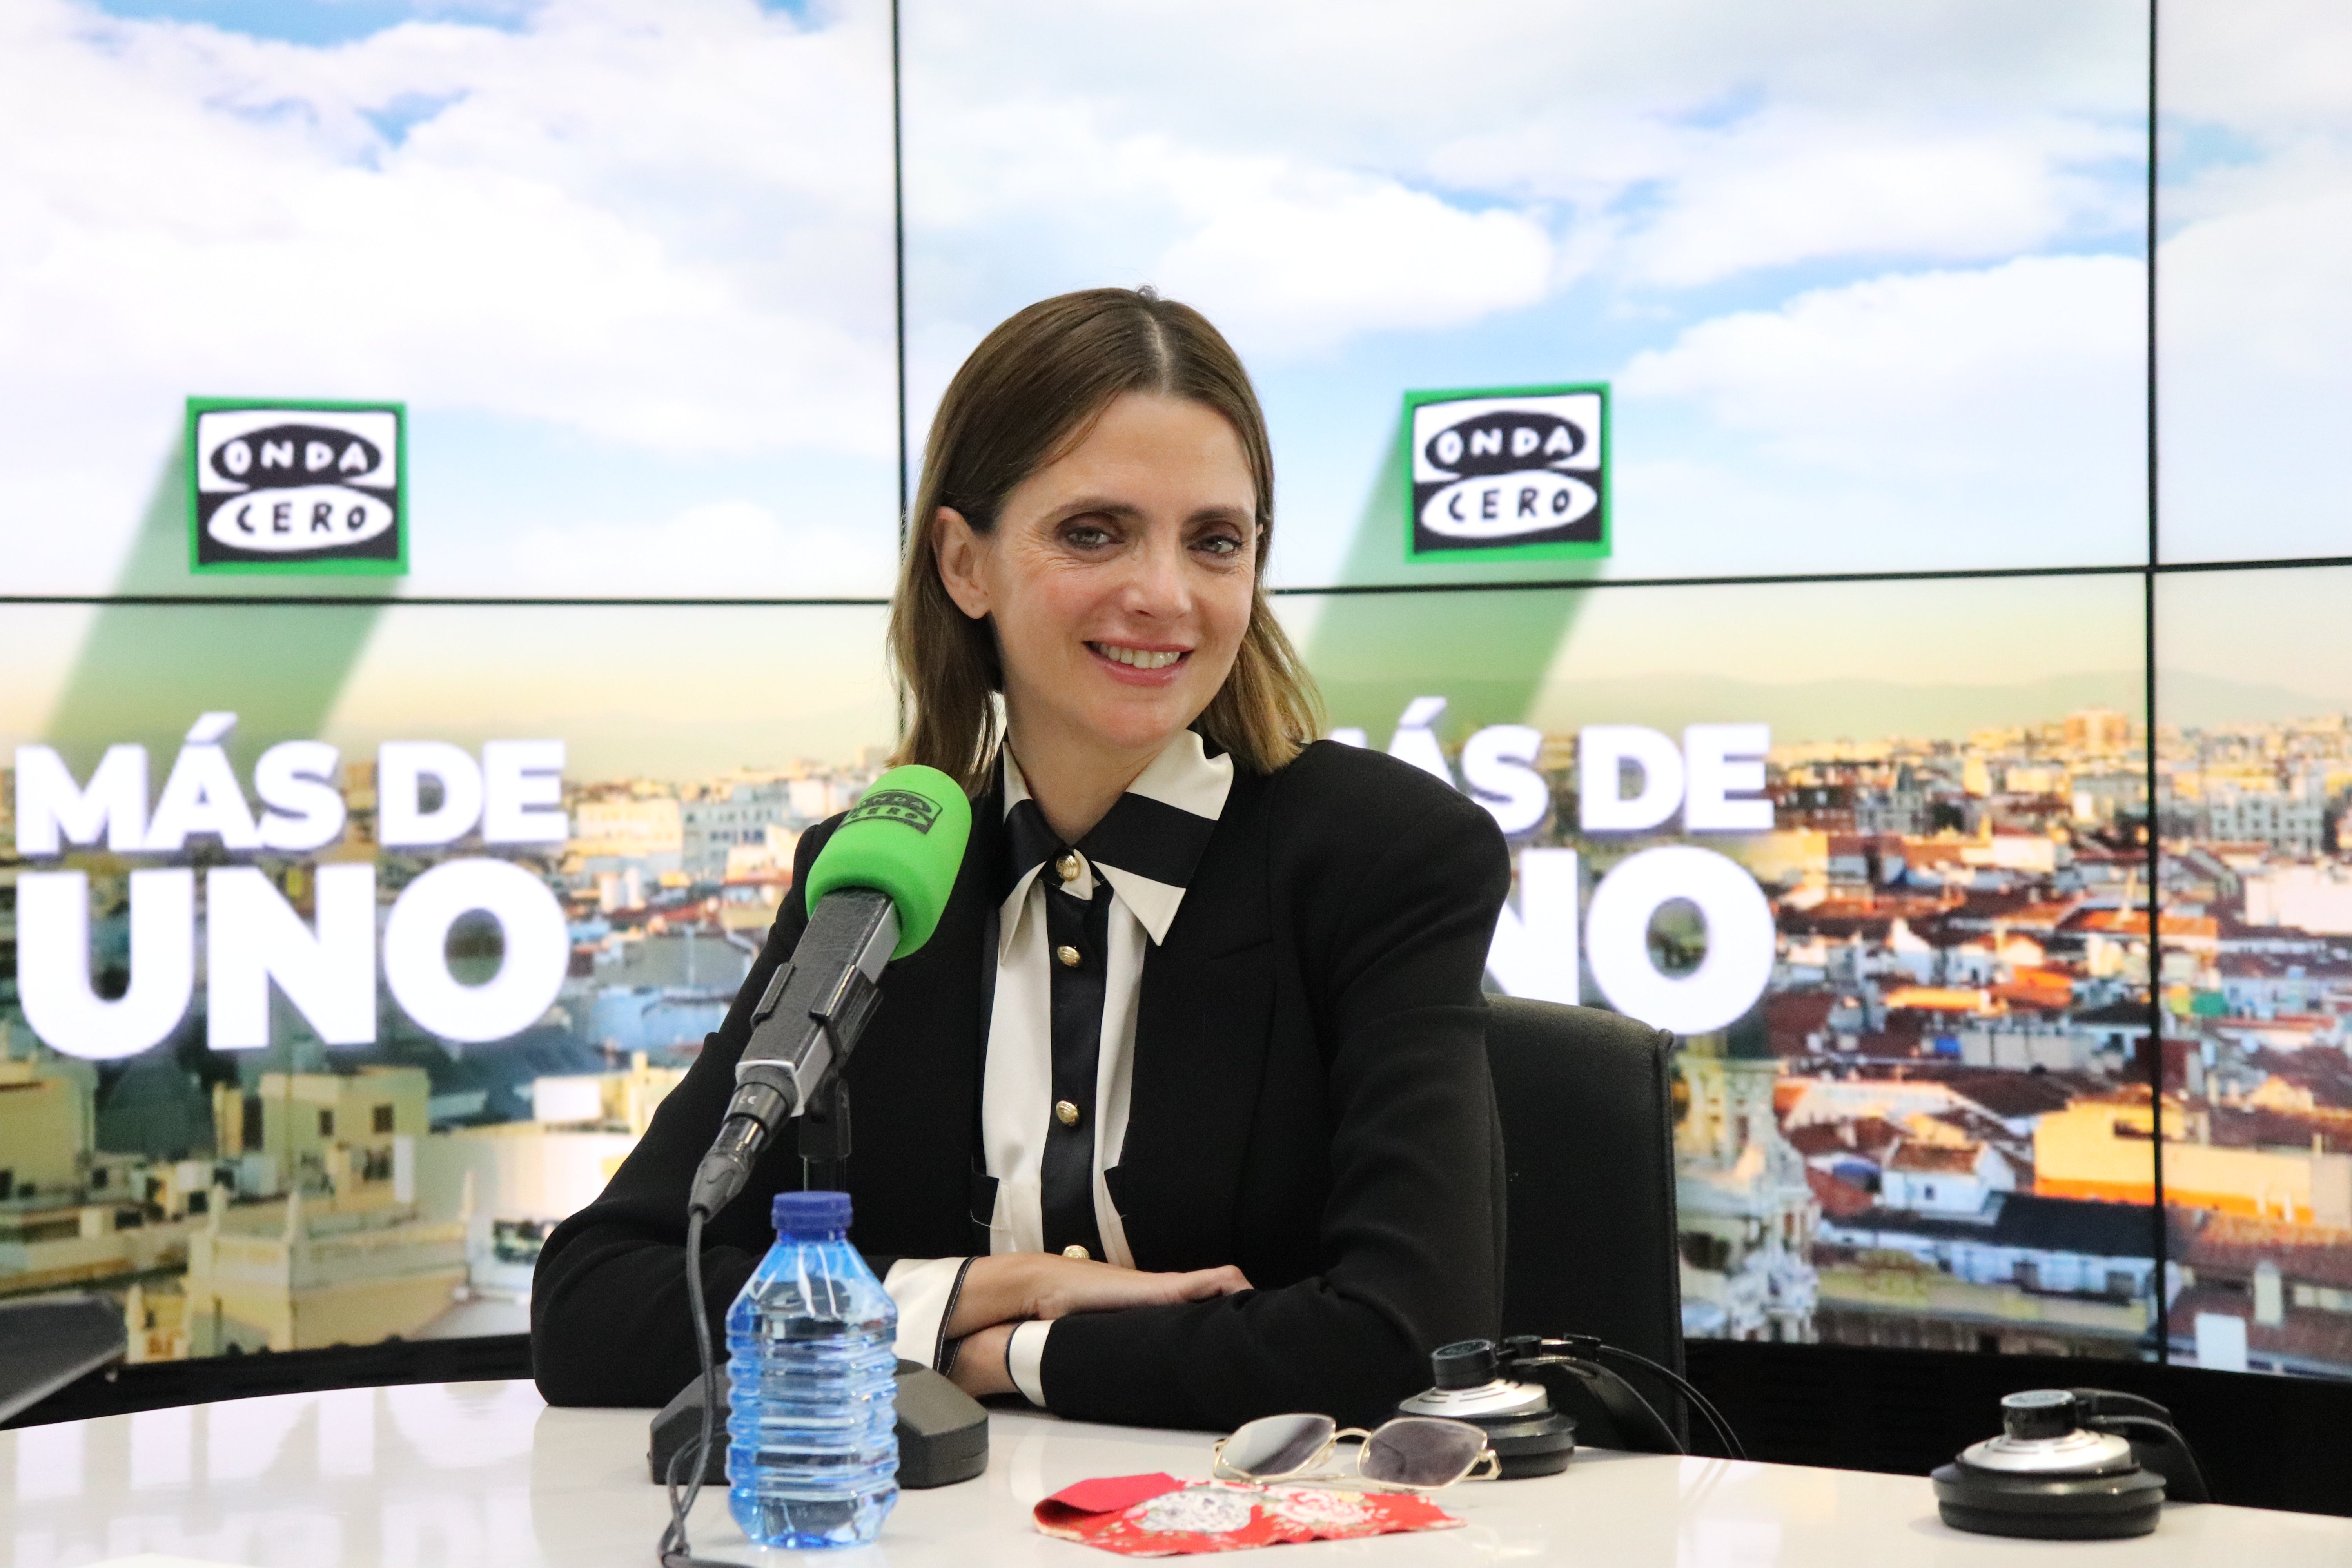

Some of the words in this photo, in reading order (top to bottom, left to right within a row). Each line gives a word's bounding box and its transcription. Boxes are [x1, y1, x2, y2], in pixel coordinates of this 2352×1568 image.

[223, 439, 368, 476] ONDA
[1436, 425, 1573, 466] ONDA
[236, 501, 366, 535] CERO
[1448, 488, 1570, 522] CERO
[15, 712, 345, 855] MÁS
[378, 739, 568, 846] DE
[1329, 695, 1549, 834] ÁS
[1578, 724, 1774, 833] DE
[16, 857, 569, 1060] UNO
[1483, 845, 1776, 1035] NO
